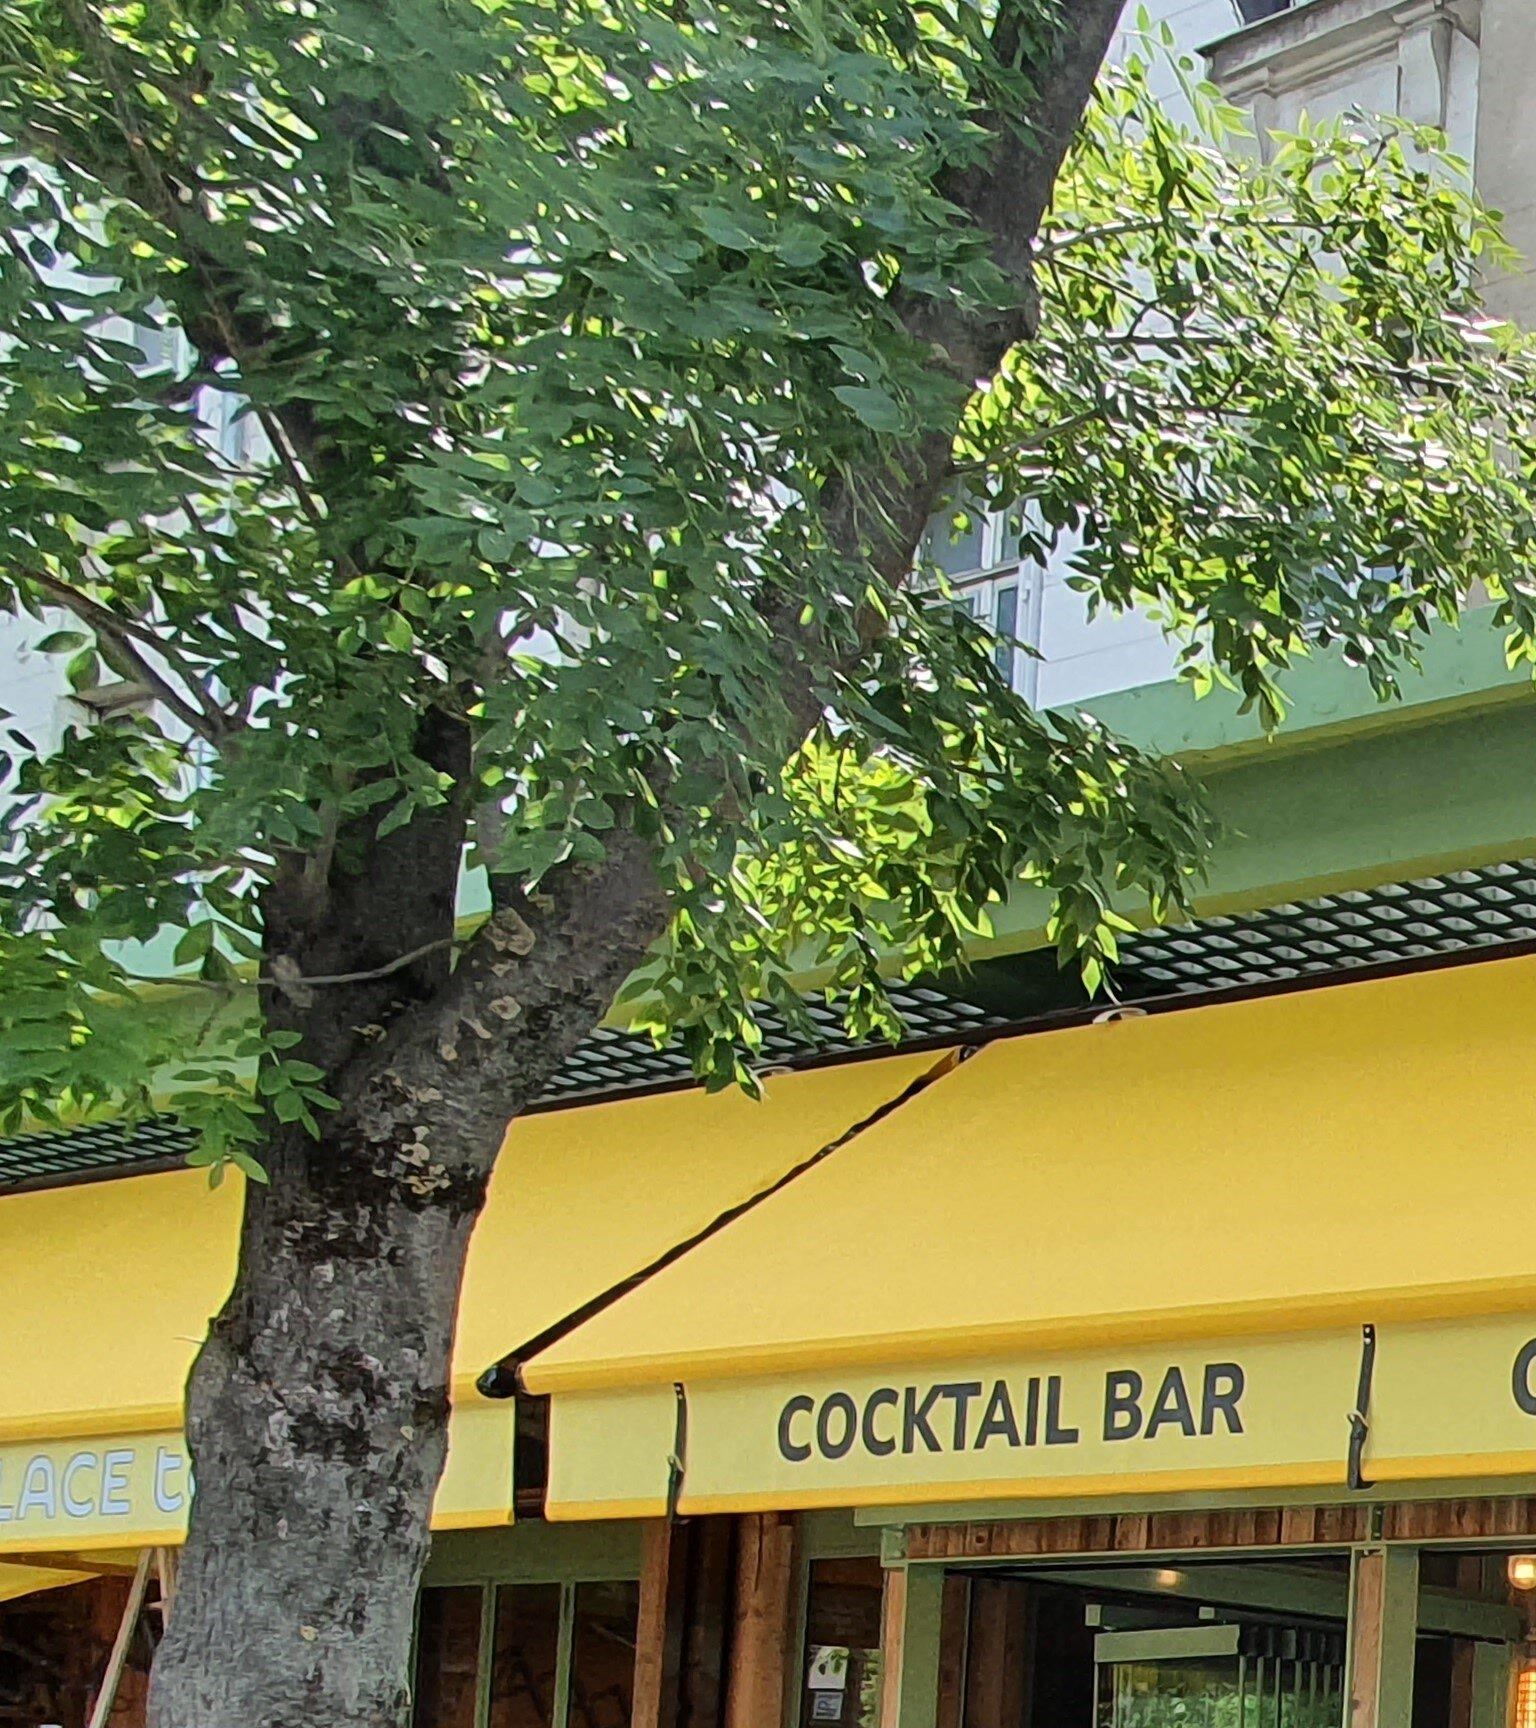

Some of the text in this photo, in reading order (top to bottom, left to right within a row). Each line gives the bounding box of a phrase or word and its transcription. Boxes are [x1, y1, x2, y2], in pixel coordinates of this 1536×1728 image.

[777, 1362, 1245, 1462] COCKTAIL BAR
[154, 1446, 195, 1515] t
